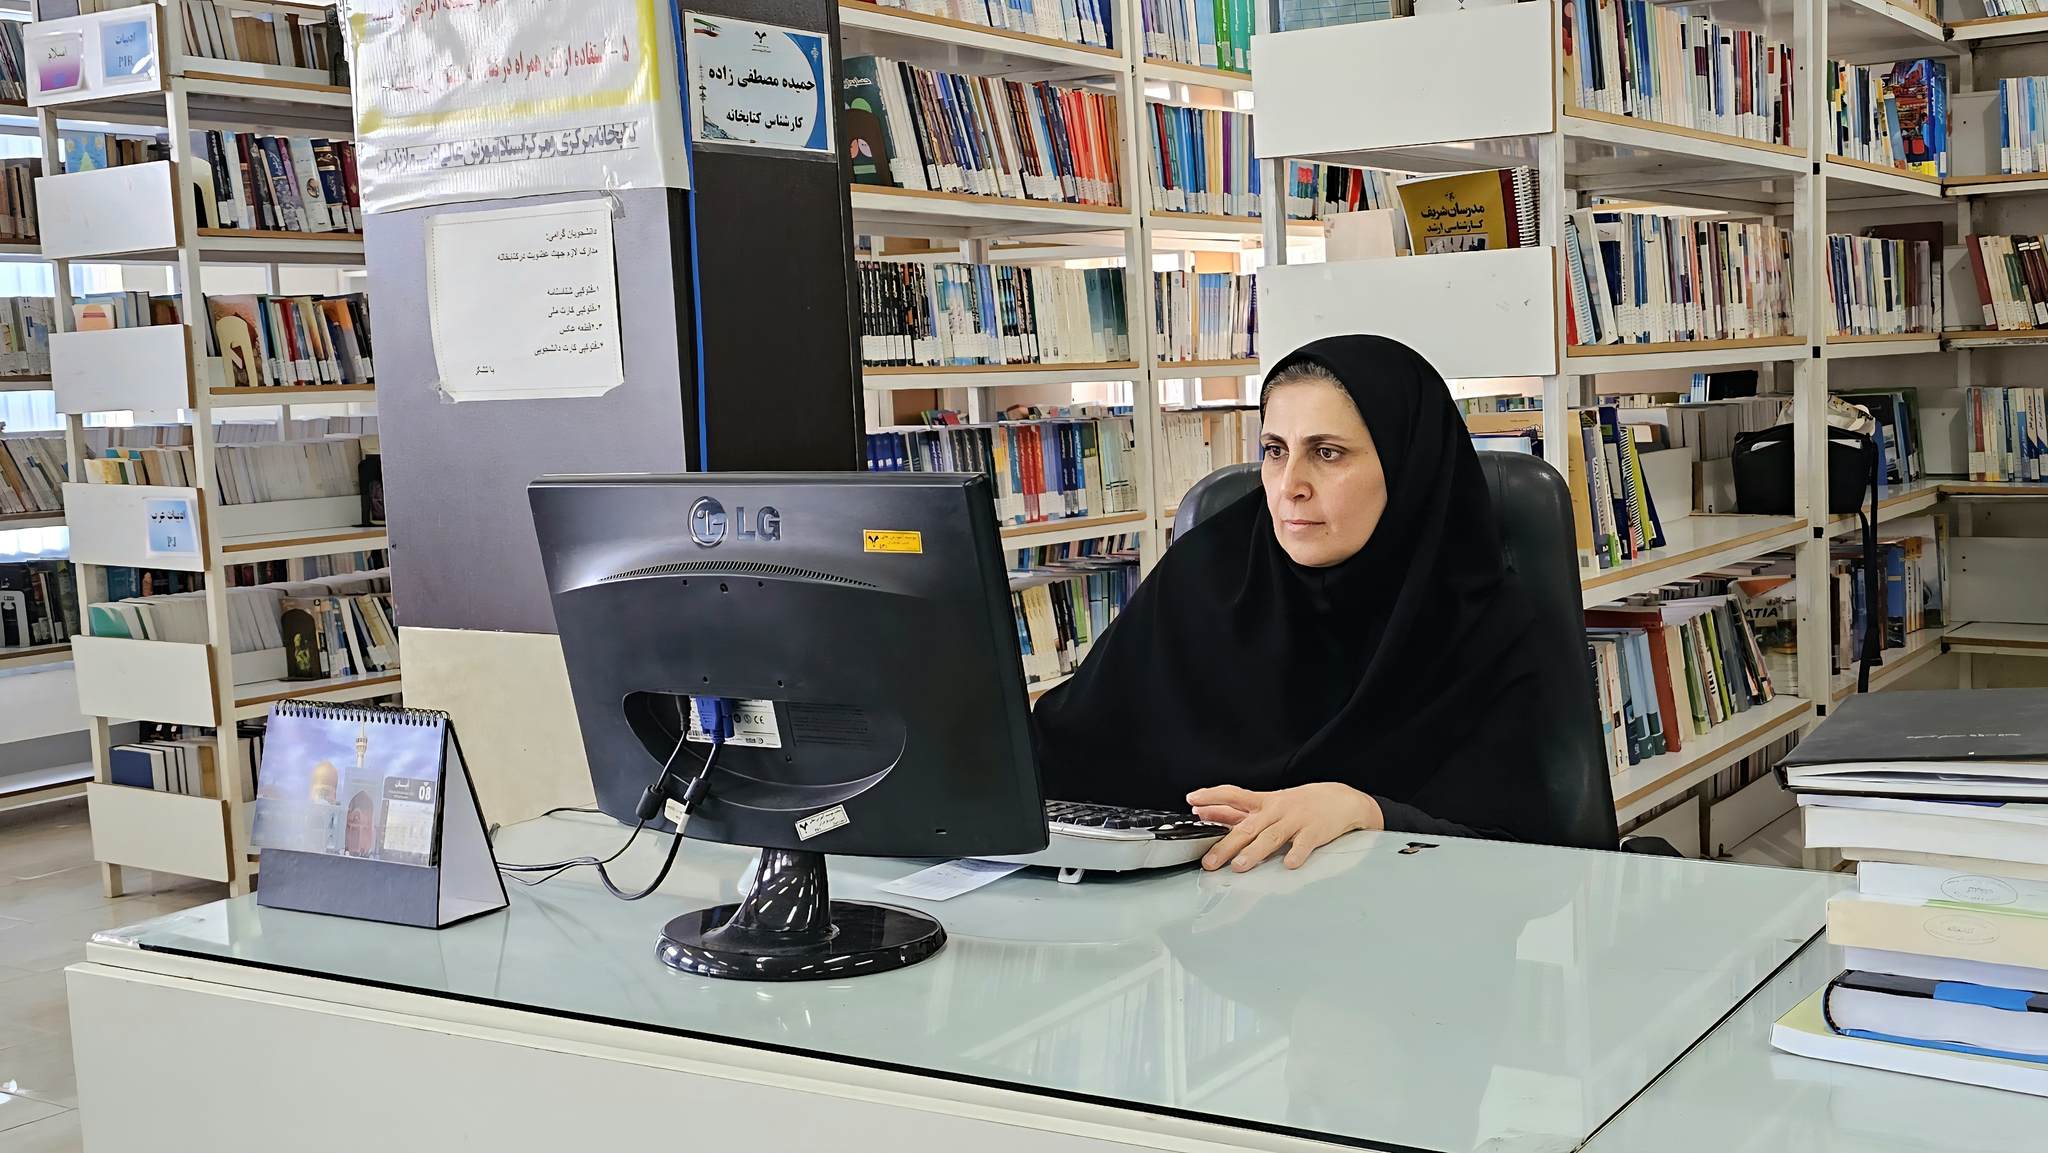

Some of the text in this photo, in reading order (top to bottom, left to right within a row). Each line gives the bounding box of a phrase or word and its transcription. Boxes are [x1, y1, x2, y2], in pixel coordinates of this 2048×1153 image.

[708, 65, 816, 93] حمیده مصطفی زاده
[726, 109, 803, 131] کارشناس کتابخانه
[1420, 201, 1485, 220] مدرسان شریف
[1426, 219, 1483, 234] کارشناسی ارشد
[736, 506, 781, 541] LG
[1744, 607, 1778, 618] ATIA
